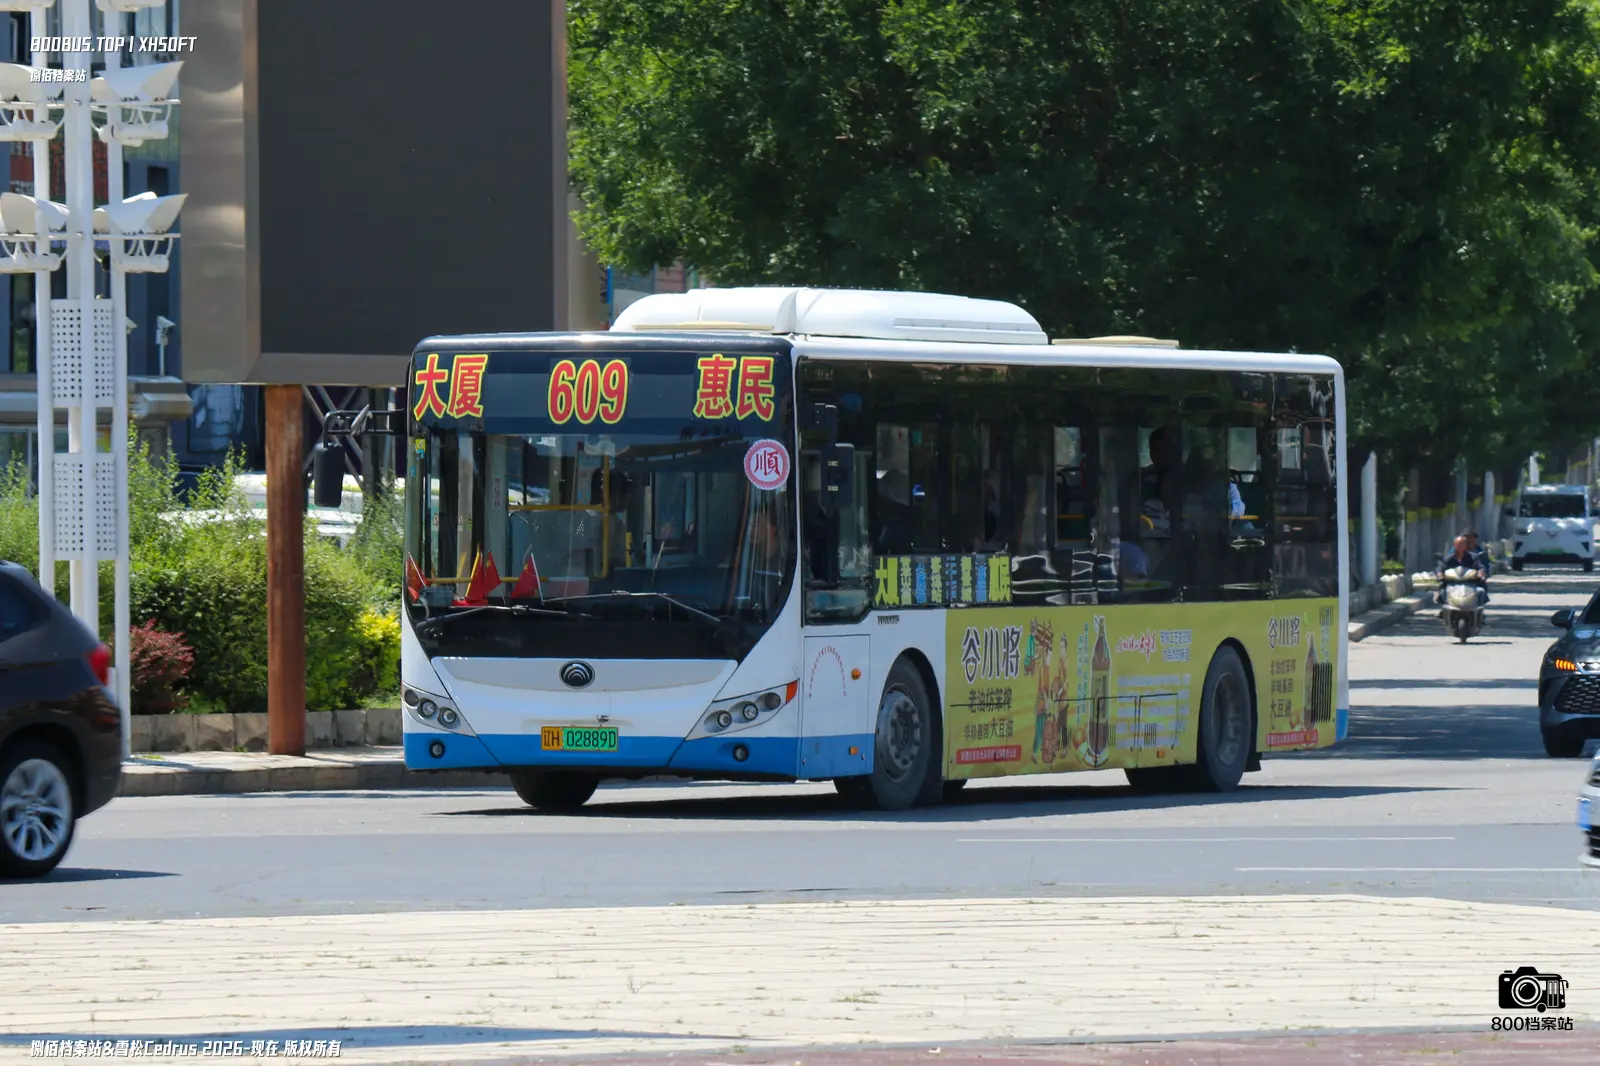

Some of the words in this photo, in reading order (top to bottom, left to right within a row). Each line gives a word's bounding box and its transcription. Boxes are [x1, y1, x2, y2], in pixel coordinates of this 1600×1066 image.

[413, 353, 489, 421] 大厦
[547, 358, 629, 425] 609
[693, 353, 776, 422] 惠民
